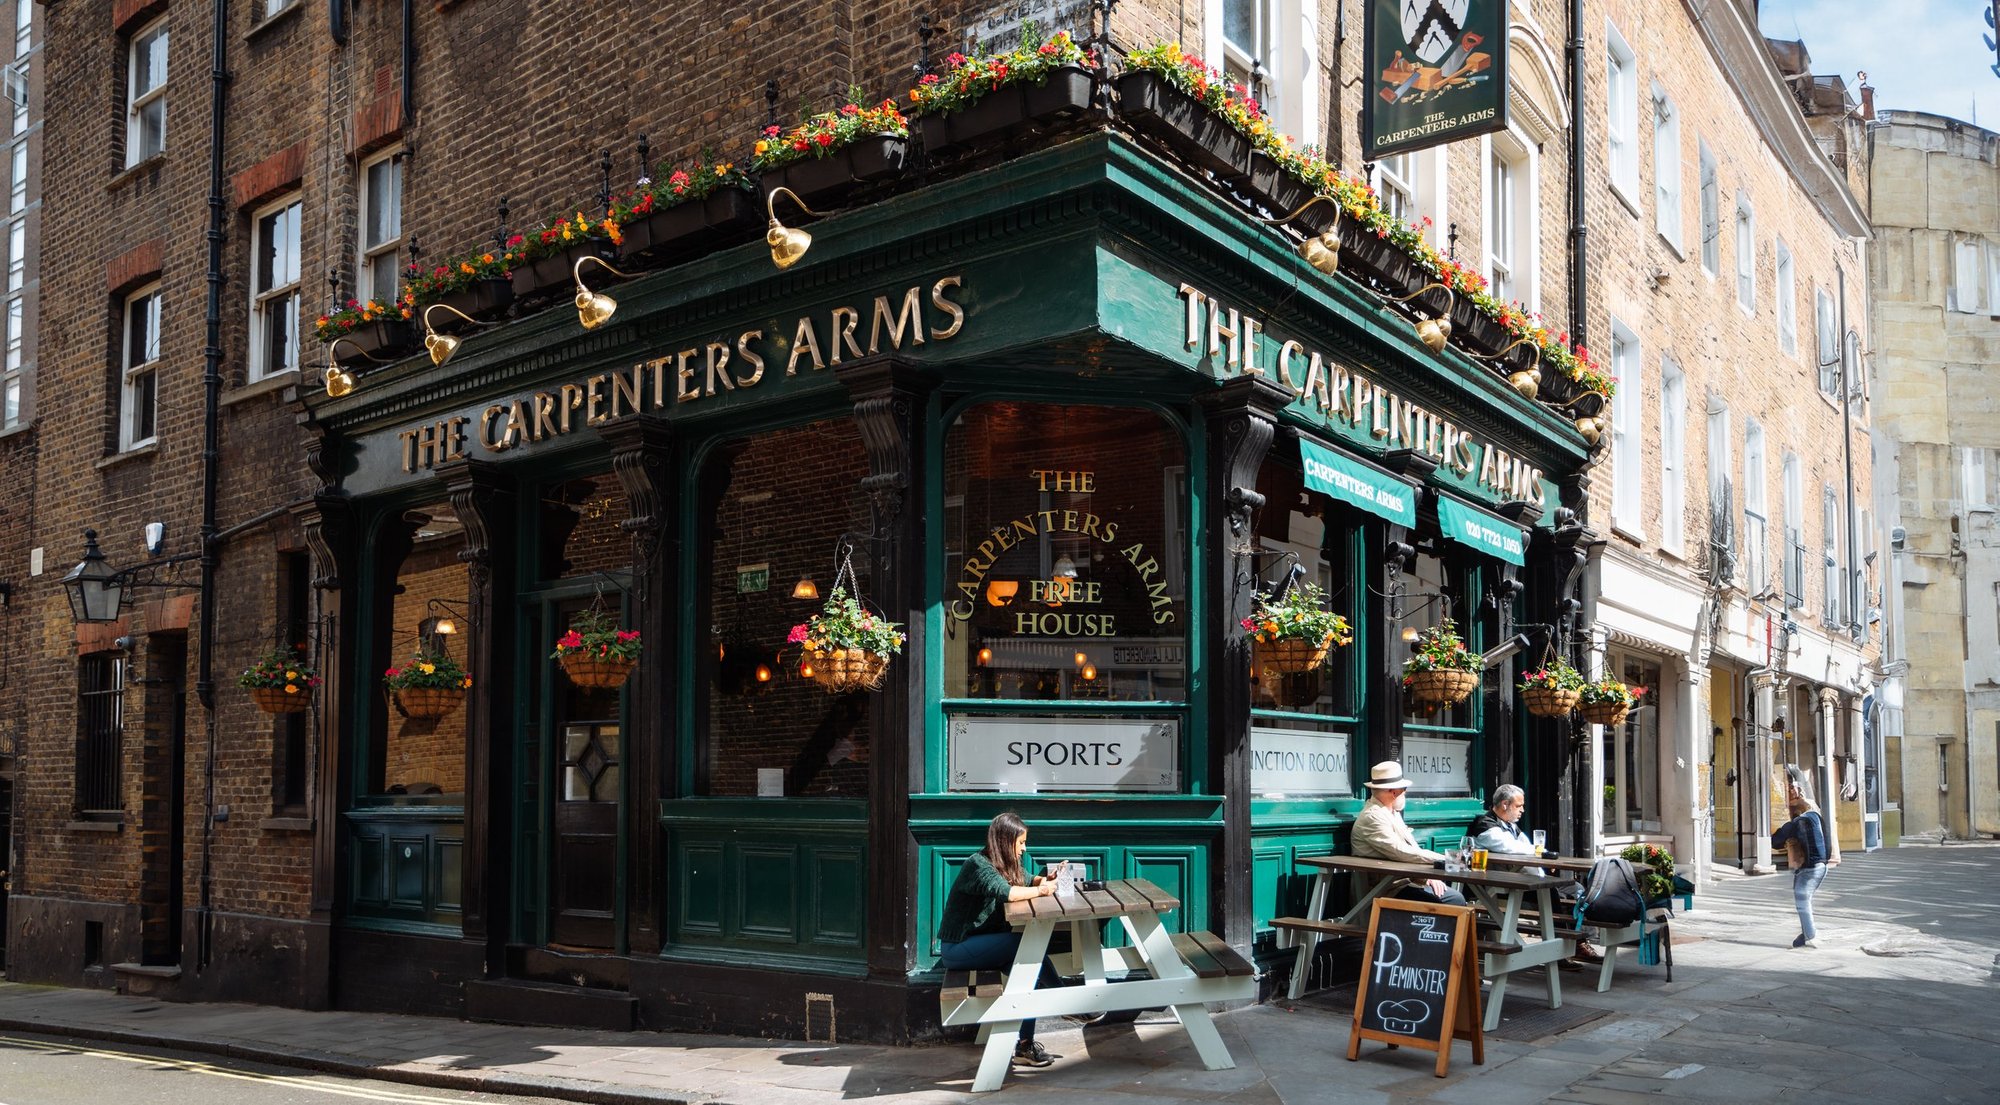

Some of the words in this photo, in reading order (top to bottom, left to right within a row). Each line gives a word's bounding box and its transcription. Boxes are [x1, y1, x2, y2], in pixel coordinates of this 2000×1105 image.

[1376, 117, 1457, 146] CARPENTERS
[1458, 107, 1496, 126] ARMS
[1424, 111, 1445, 124] THE
[398, 415, 464, 473] THE
[479, 330, 765, 452] CARPENTERS
[785, 275, 964, 376] ARMS
[1179, 282, 1265, 377] THE
[1280, 339, 1475, 476] CARPENTERS
[1479, 442, 1545, 507] ARMS
[1032, 469, 1097, 493] THE
[1304, 457, 1374, 501] CARPENTERS
[1376, 488, 1404, 513] ARMS
[1465, 520, 1481, 540] 020
[951, 509, 1119, 621] CARPENTERS
[1120, 542, 1176, 625] ARMS
[1029, 579, 1103, 604] FREE
[1015, 612, 1117, 637] HOUSE
[1006, 741, 1123, 766] SPORTS
[1308, 752, 1347, 774] ROOM
[1407, 755, 1428, 774] FINE
[1430, 755, 1452, 775] ALES
[1373, 931, 1447, 996] PIEMINSTER
